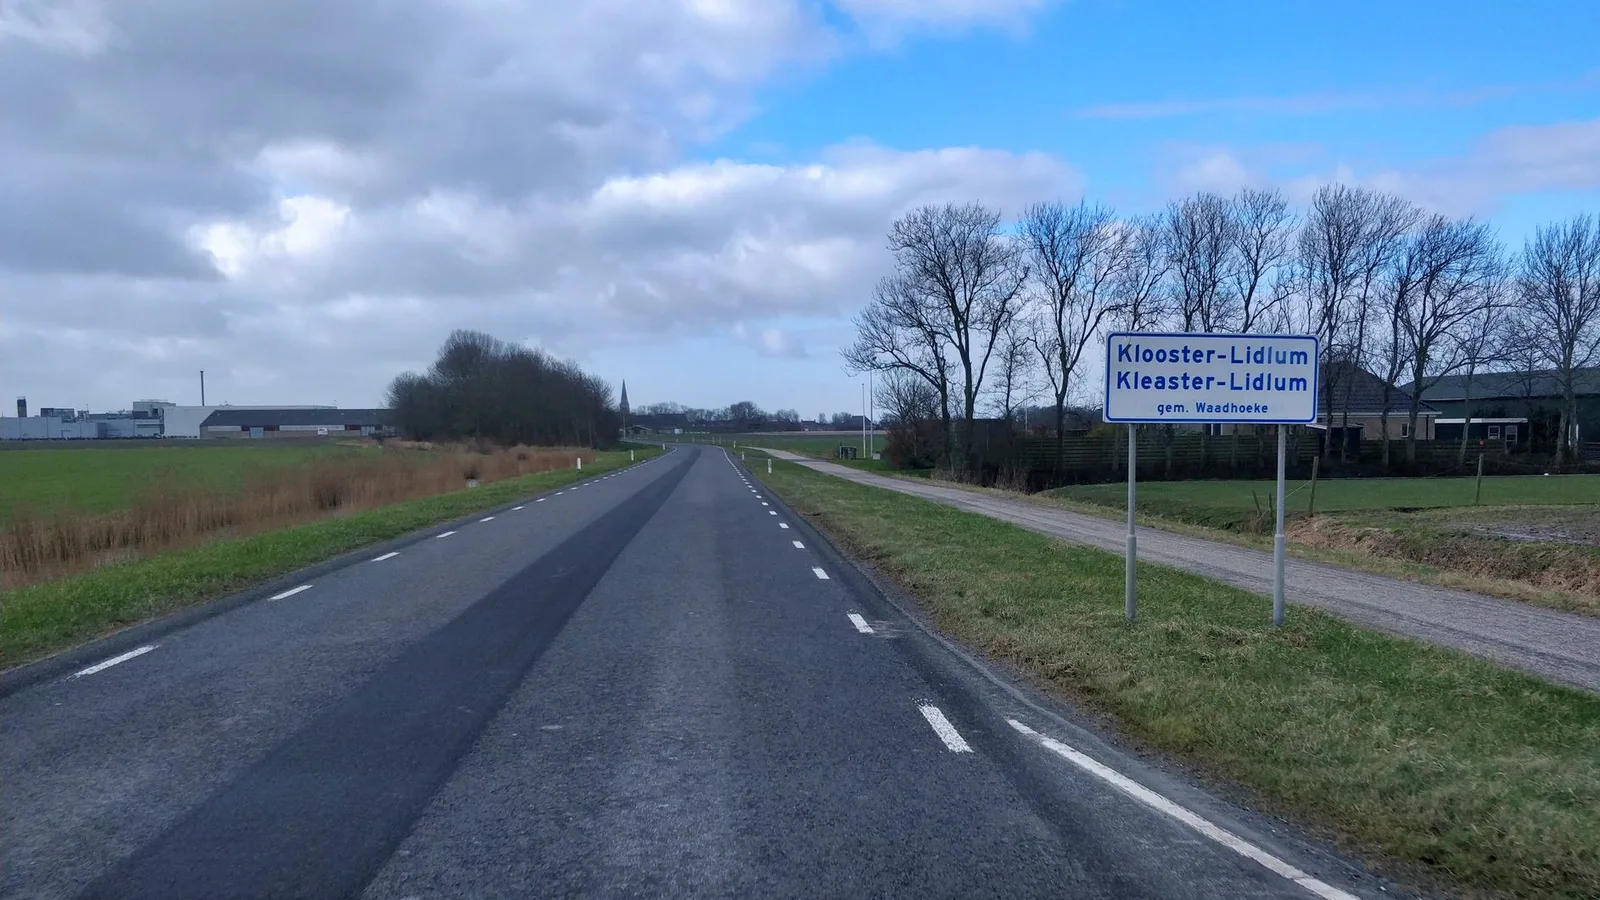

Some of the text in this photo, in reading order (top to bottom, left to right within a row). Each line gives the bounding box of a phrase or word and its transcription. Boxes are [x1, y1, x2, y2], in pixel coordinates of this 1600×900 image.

[1118, 343, 1308, 365] Klooster-Lidlum
[1116, 371, 1307, 391] Kleaster-Lidlum
[1157, 402, 1268, 415] gem. Waadhoeke
